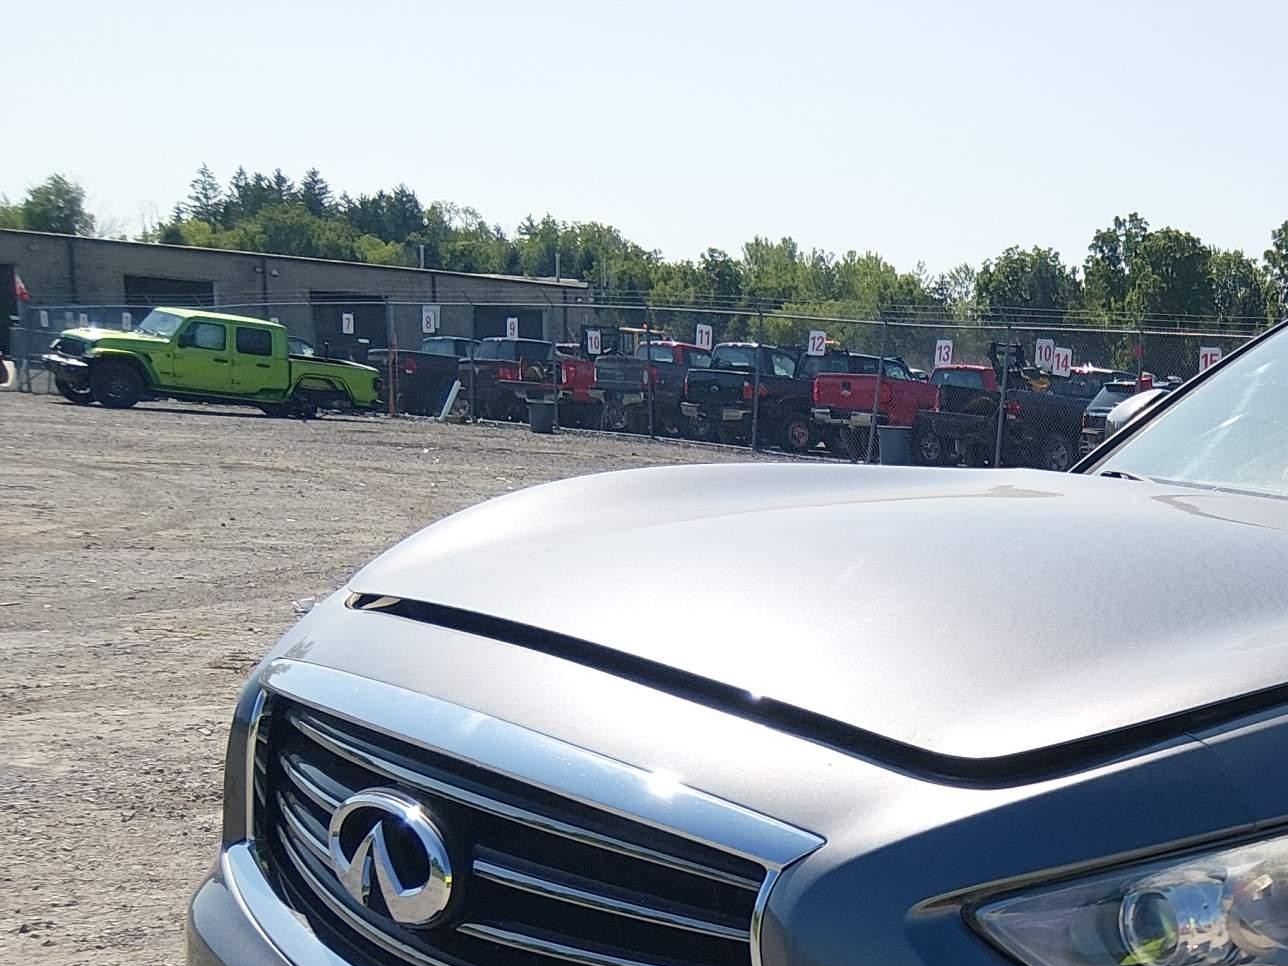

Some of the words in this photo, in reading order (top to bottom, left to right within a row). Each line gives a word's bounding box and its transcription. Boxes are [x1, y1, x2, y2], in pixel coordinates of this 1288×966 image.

[346, 318, 350, 329] 7
[426, 316, 432, 329] 8
[510, 322, 515, 336] 9
[589, 336, 600, 349] 10
[698, 330, 710, 348] 11
[811, 336, 825, 352] 12
[937, 345, 950, 361] 13
[1038, 345, 1052, 361] 10
[1056, 354, 1069, 372] 14
